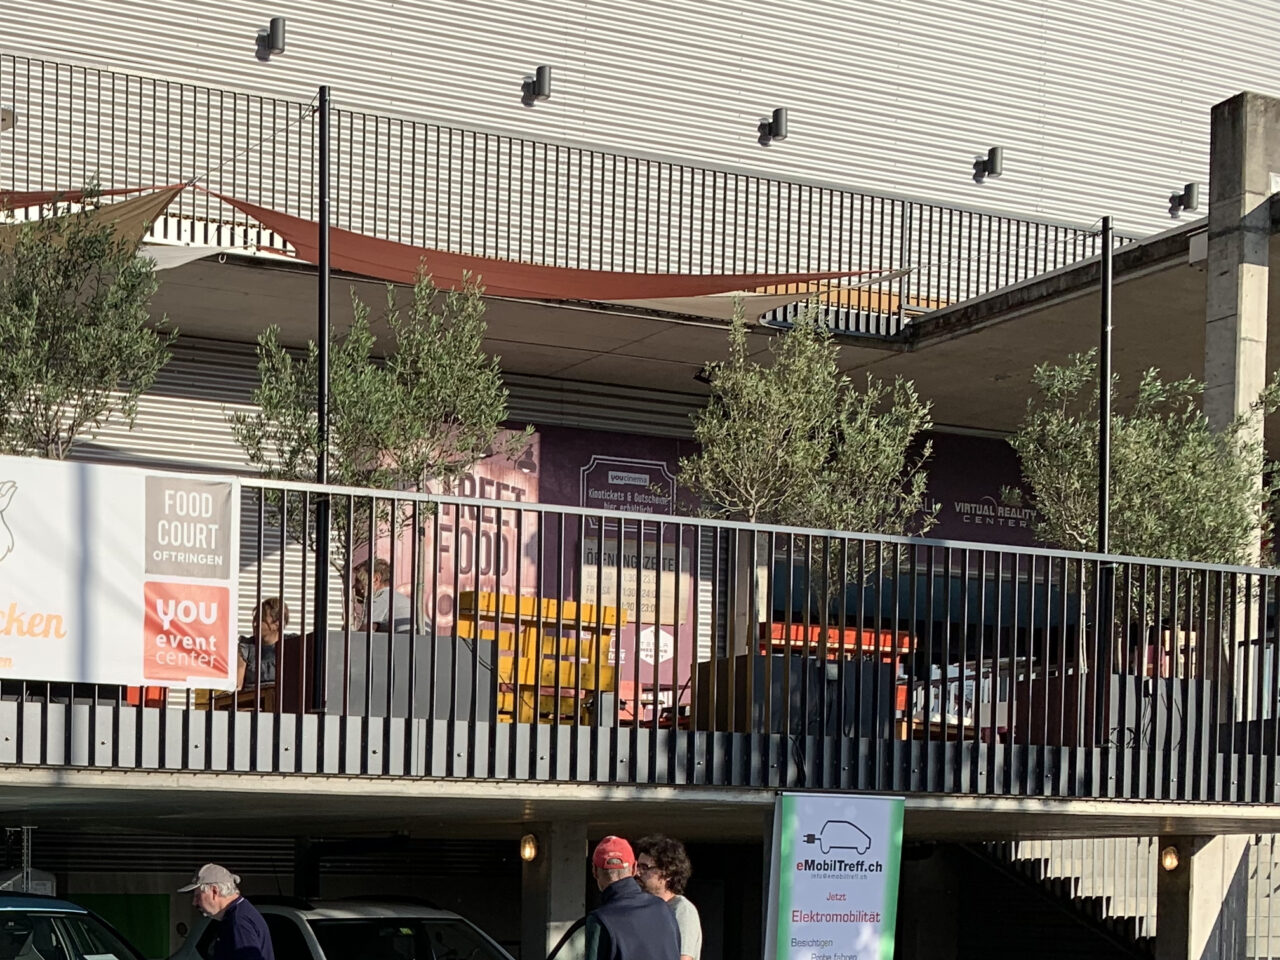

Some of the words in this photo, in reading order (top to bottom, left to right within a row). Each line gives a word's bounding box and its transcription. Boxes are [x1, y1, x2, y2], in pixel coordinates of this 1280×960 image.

[164, 489, 213, 518] FOOD
[627, 493, 632, 501] &
[955, 501, 996, 517] VIRTUAL
[997, 505, 1037, 520] REALITY
[963, 516, 1028, 528] CENTER
[157, 520, 219, 549] COURT
[152, 550, 223, 566] OFTRINGEN
[438, 523, 509, 577] FOOD
[156, 633, 217, 652] event
[155, 650, 217, 668] center
[796, 859, 883, 872] eMobilTreff.ch
[826, 892, 847, 901] Jetzt
[791, 909, 881, 923] Elektromobilität
[790, 937, 834, 949] Besichtigen
